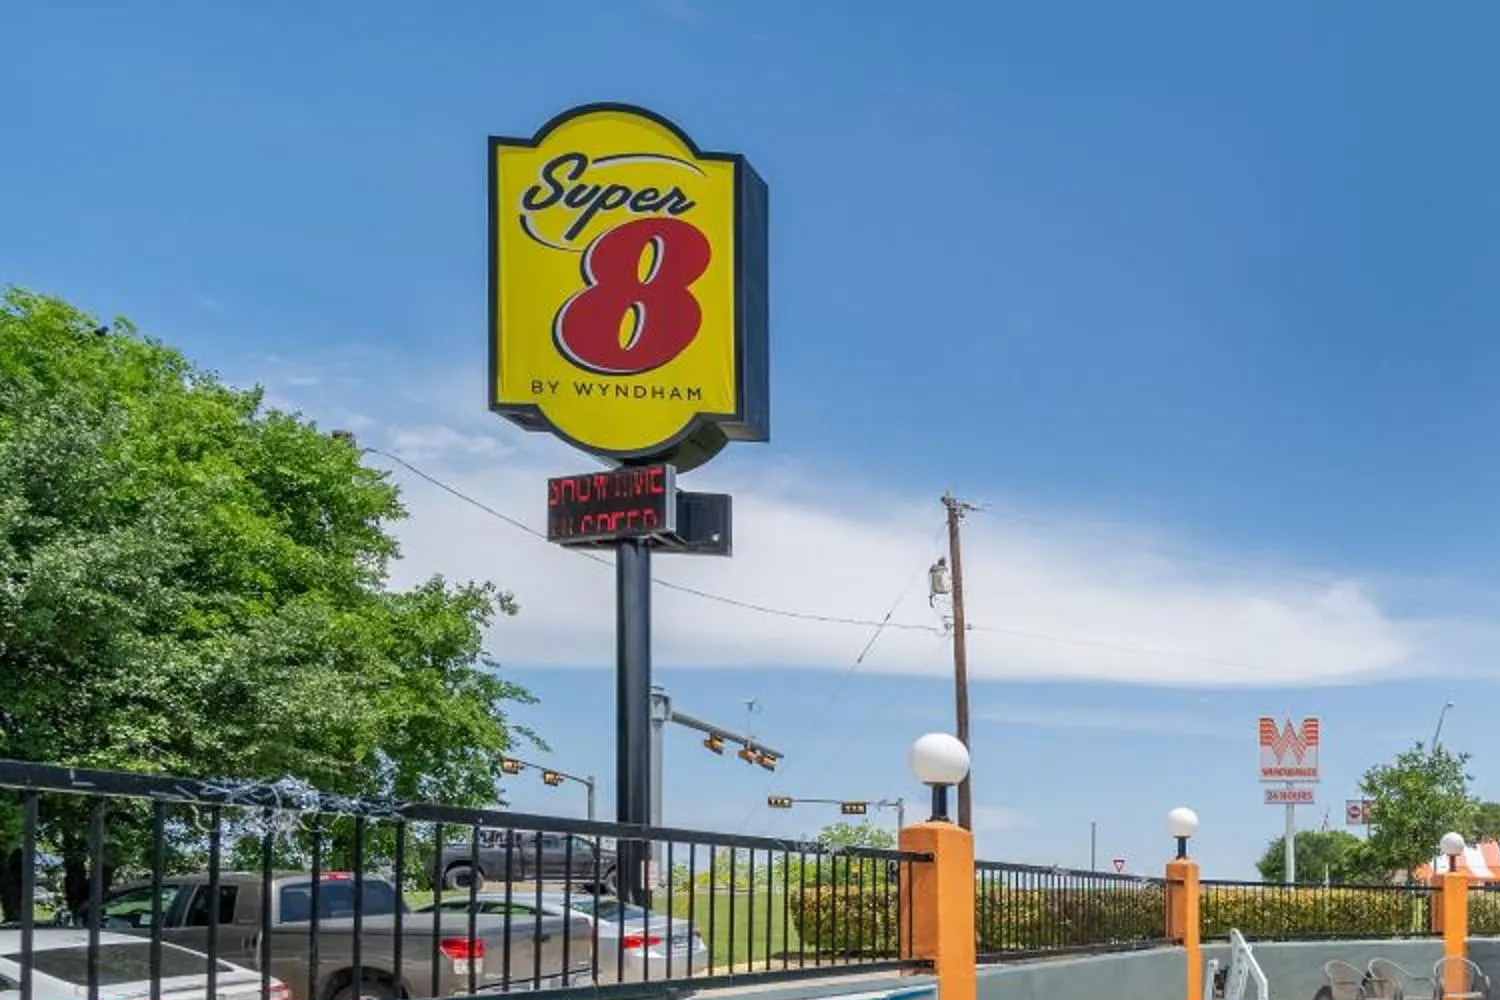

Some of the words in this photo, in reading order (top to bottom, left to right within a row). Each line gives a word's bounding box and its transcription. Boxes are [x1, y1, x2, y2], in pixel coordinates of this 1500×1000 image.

[522, 152, 696, 241] Super
[552, 217, 711, 376] 8
[531, 380, 560, 395] BY
[573, 382, 702, 401] WYNDHAM
